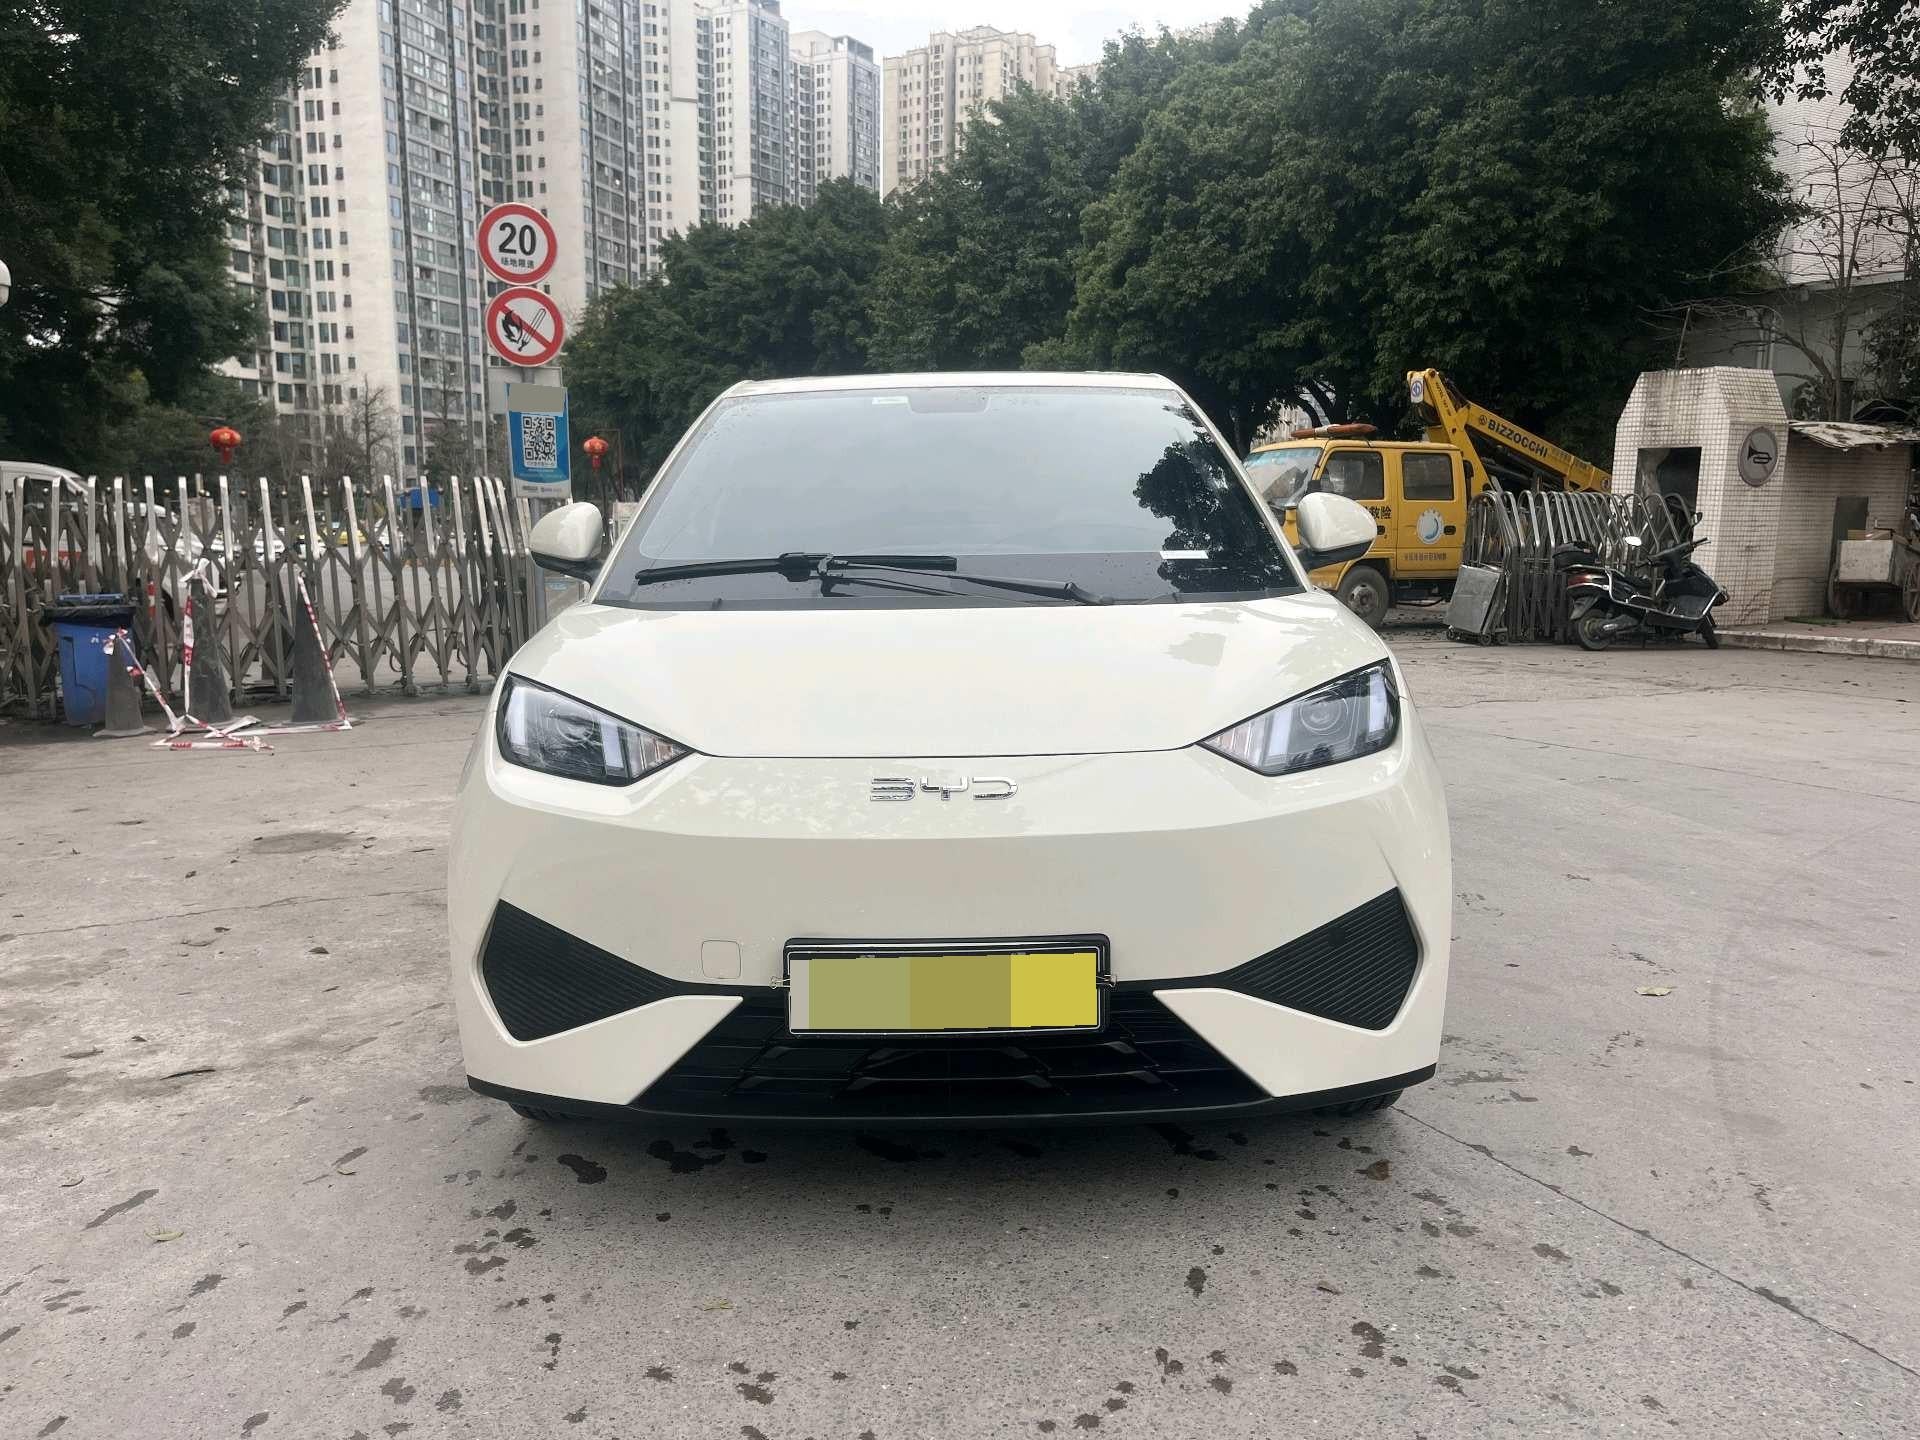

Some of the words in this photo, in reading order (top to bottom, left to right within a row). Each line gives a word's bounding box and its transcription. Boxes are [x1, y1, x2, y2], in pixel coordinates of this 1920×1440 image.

[499, 222, 536, 256] 20
[1488, 419, 1548, 458] BIZZOCCHI
[1365, 505, 1392, 519] 救险
[870, 775, 1018, 802] BYD
